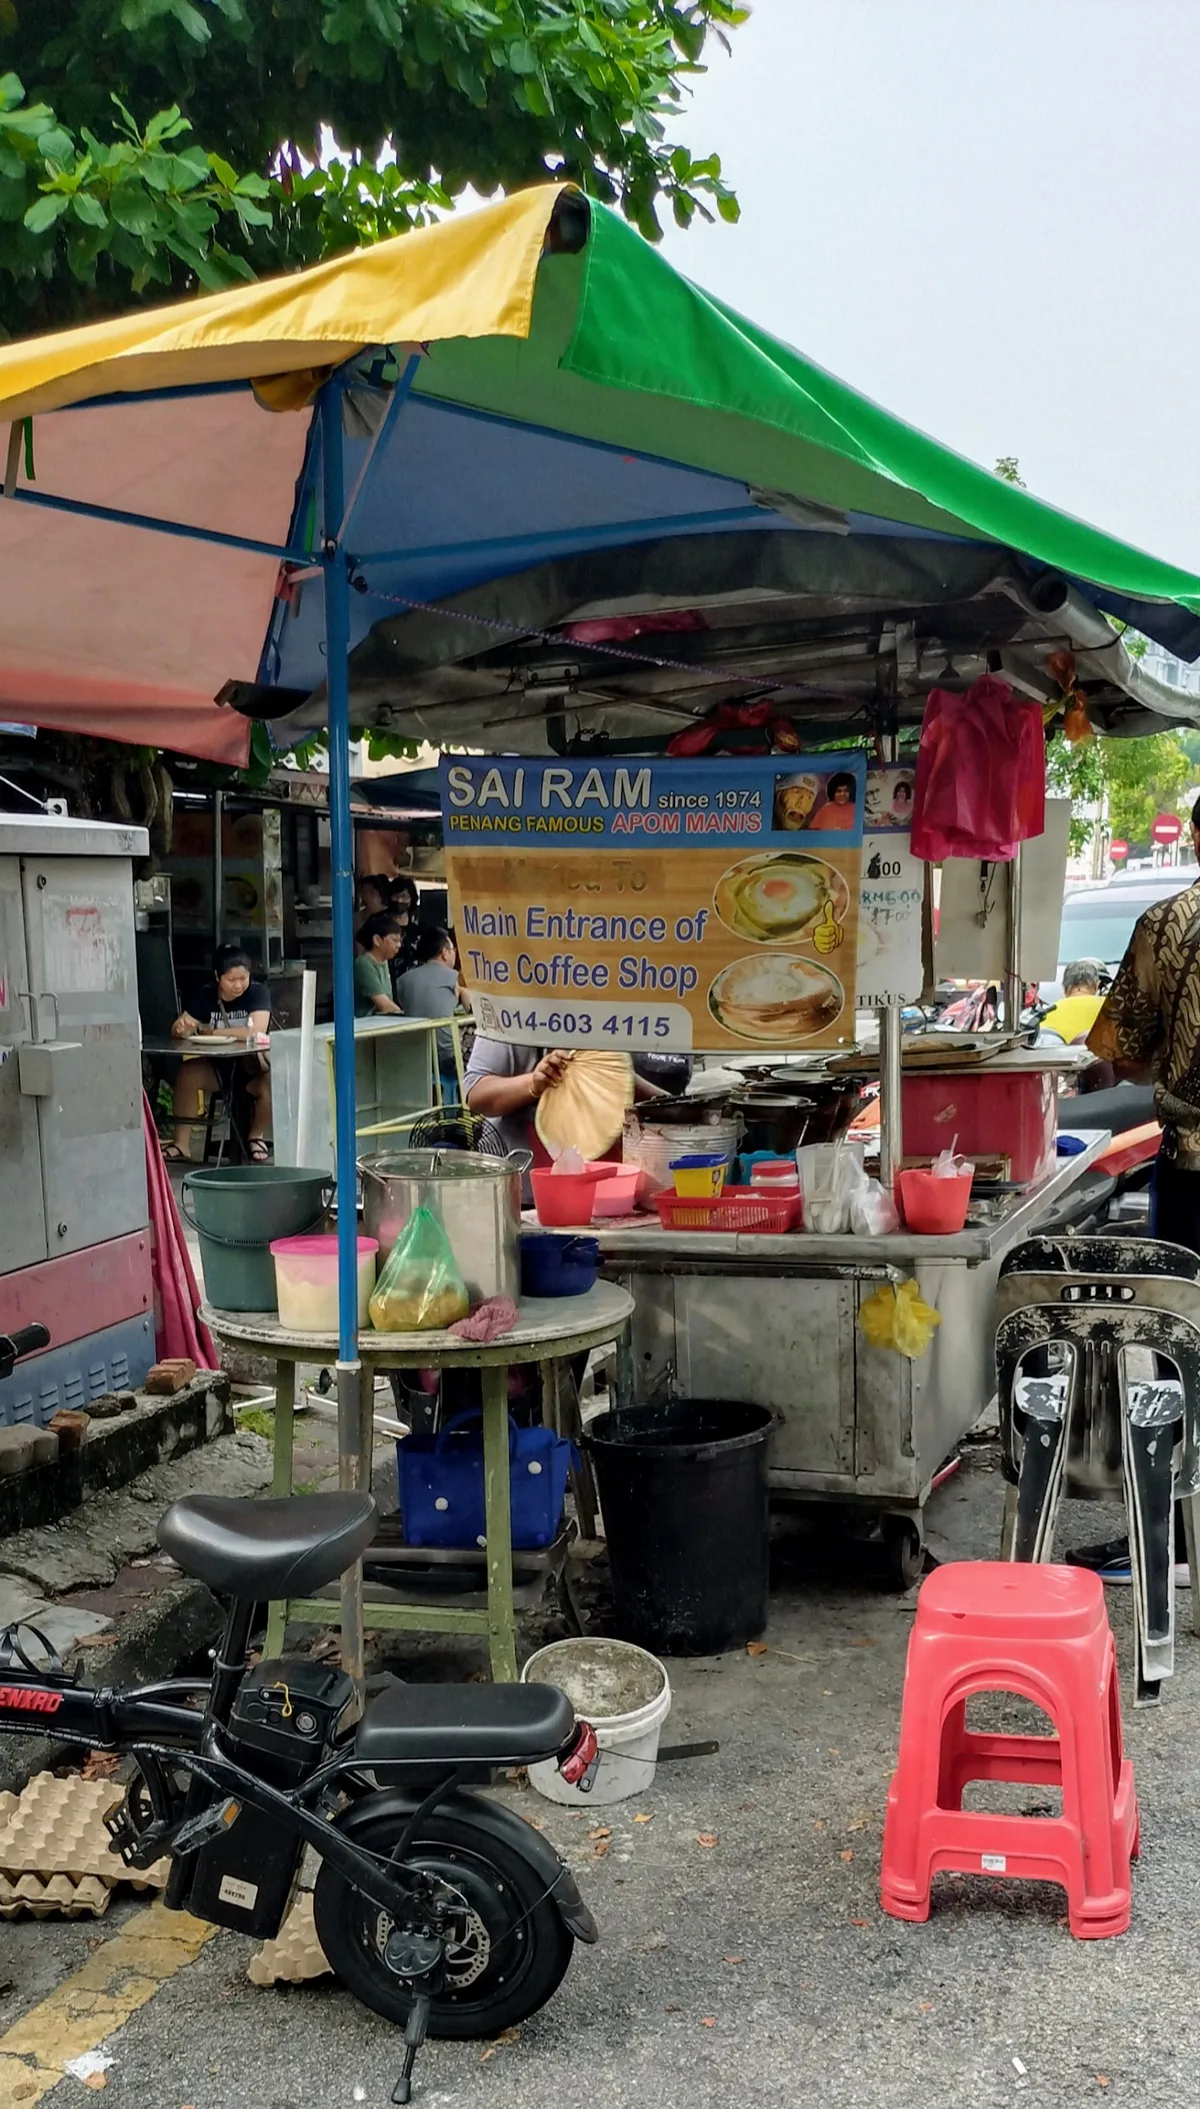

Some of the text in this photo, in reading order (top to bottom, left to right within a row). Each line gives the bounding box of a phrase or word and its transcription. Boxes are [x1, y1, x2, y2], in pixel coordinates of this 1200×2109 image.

[449, 766, 761, 808] SAI RAM since 1974
[449, 812, 762, 834] PENANG FAMOUS APOM MANIS
[463, 904, 709, 942] Main Entrance of
[467, 949, 698, 998] The Coffee Shop
[856, 993, 906, 1007] TIKUS
[501, 1009, 671, 1037] 014-603 4115
